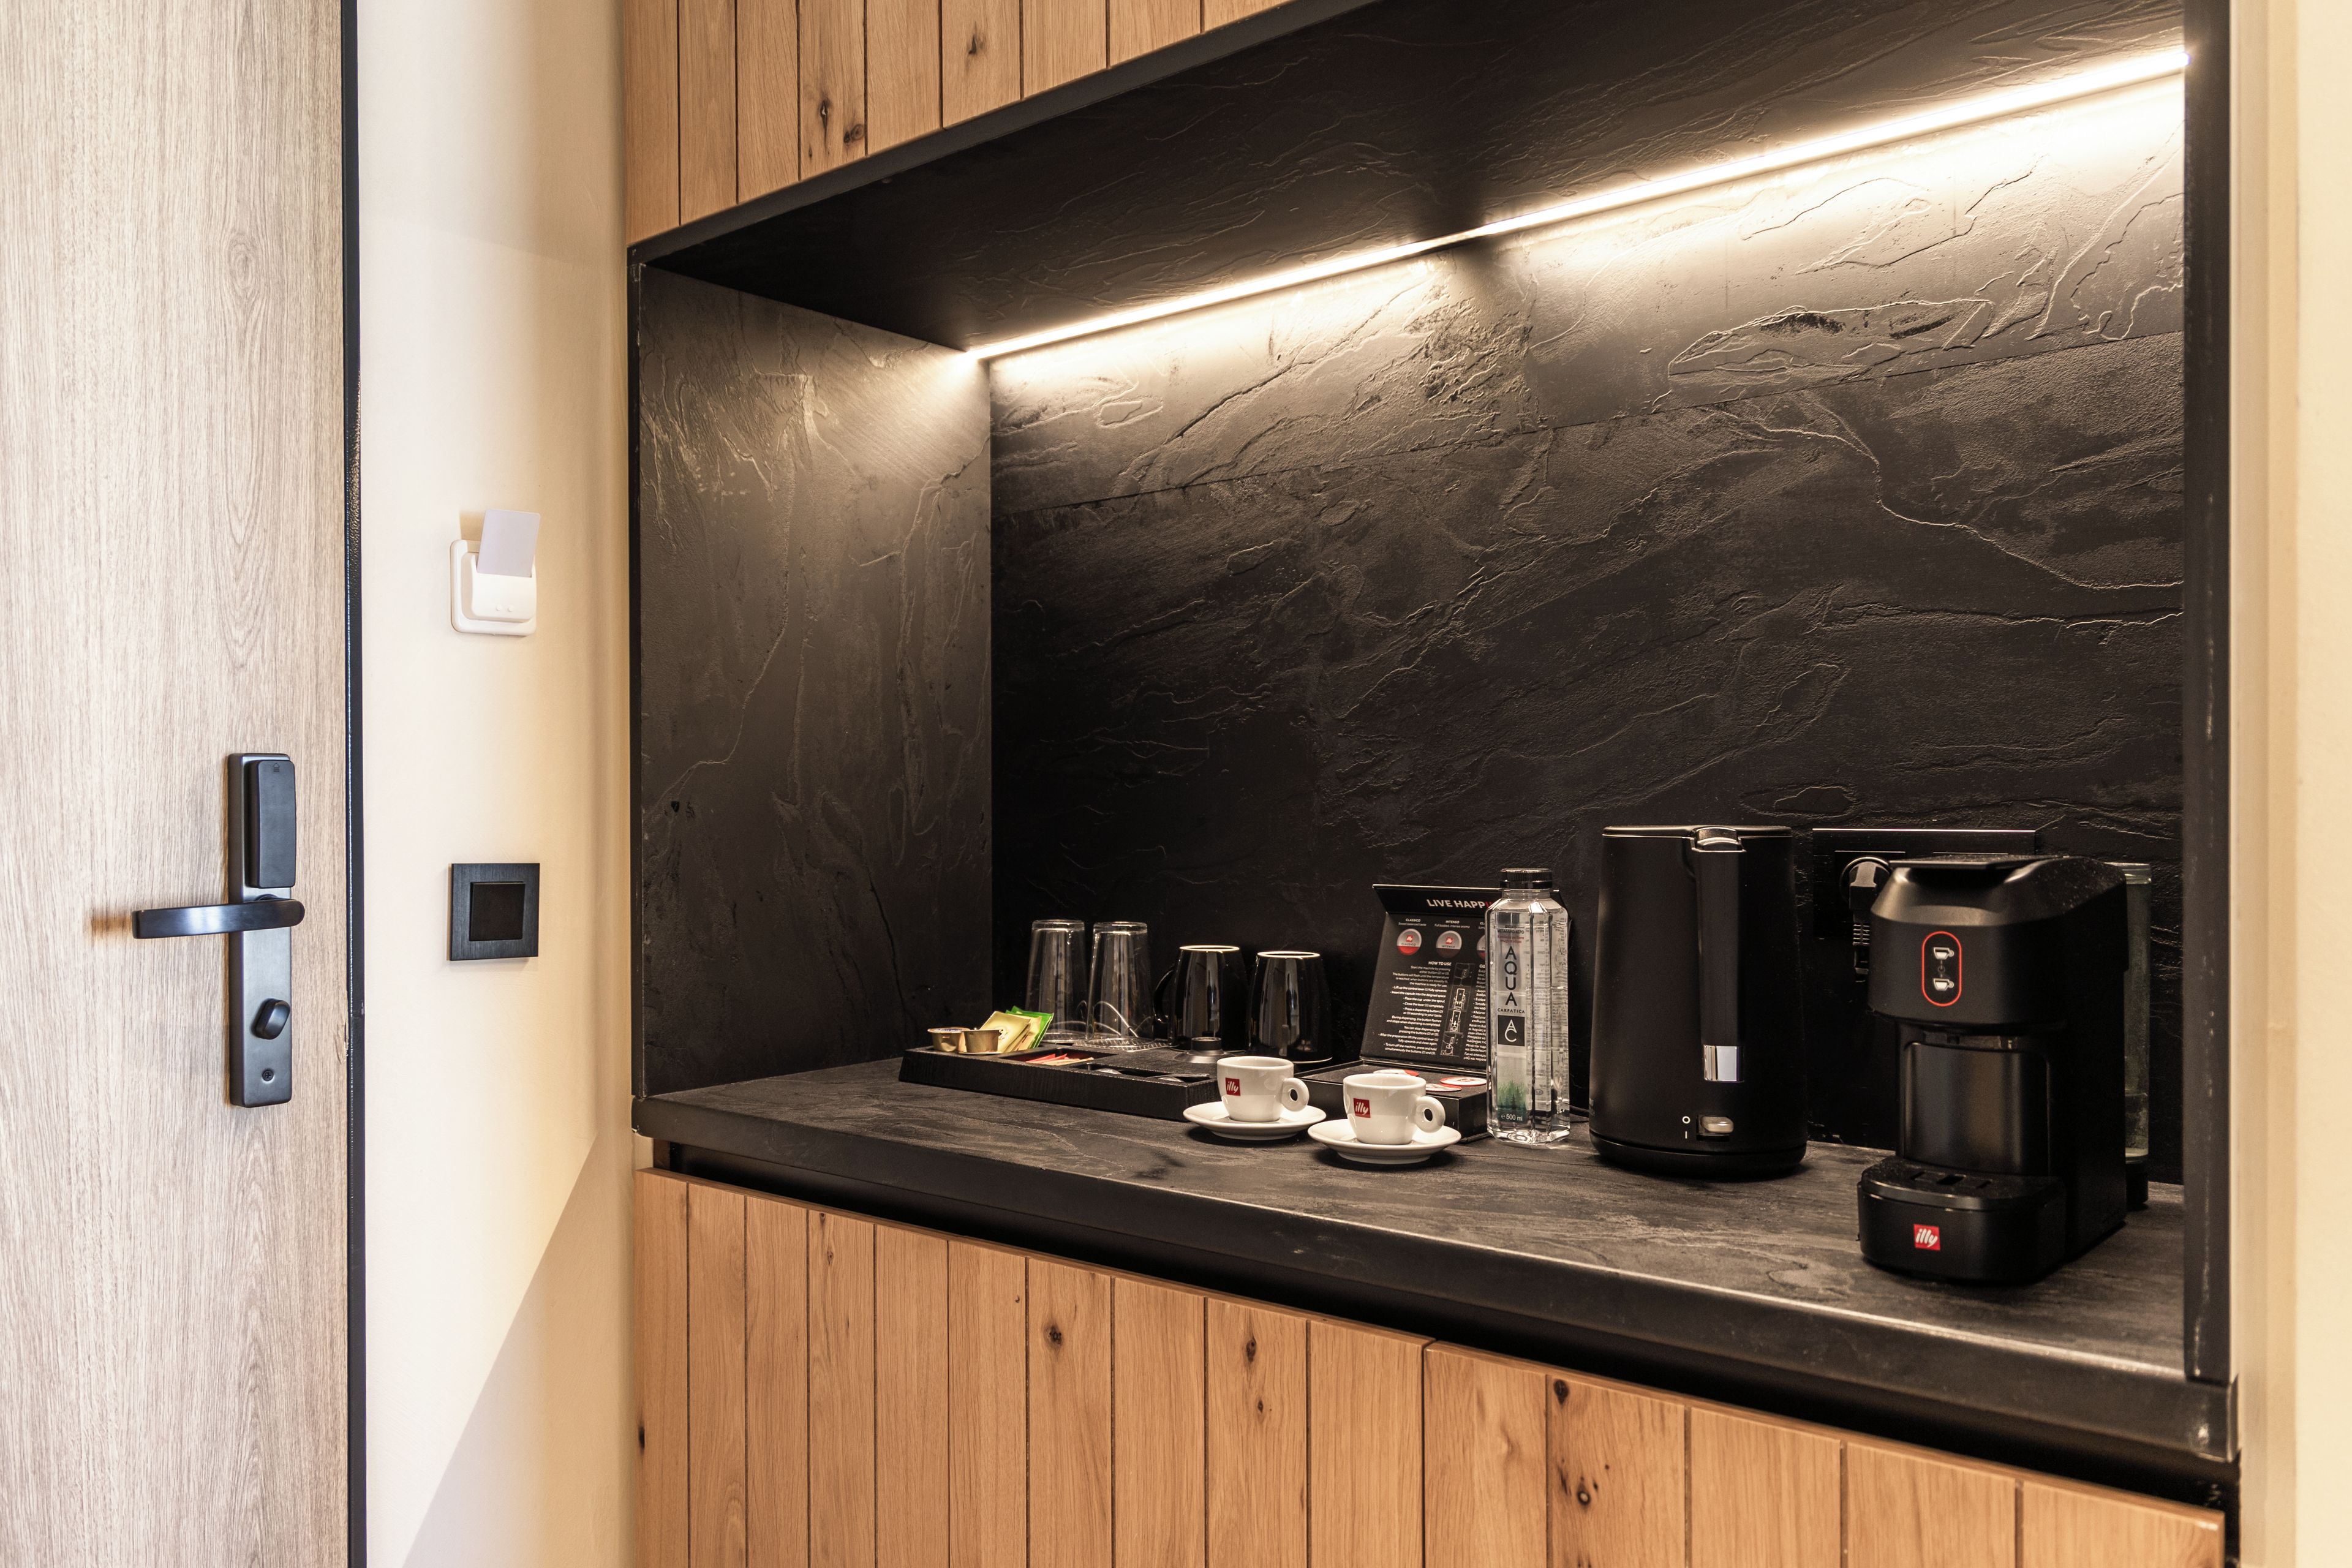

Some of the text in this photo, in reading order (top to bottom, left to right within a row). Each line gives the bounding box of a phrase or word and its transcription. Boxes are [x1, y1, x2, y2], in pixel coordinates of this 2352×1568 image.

[1504, 946, 1517, 1006] AQUA
[1227, 1080, 1238, 1093] illy
[1355, 1102, 1368, 1115] illy
[1916, 1229, 1938, 1247] illy
